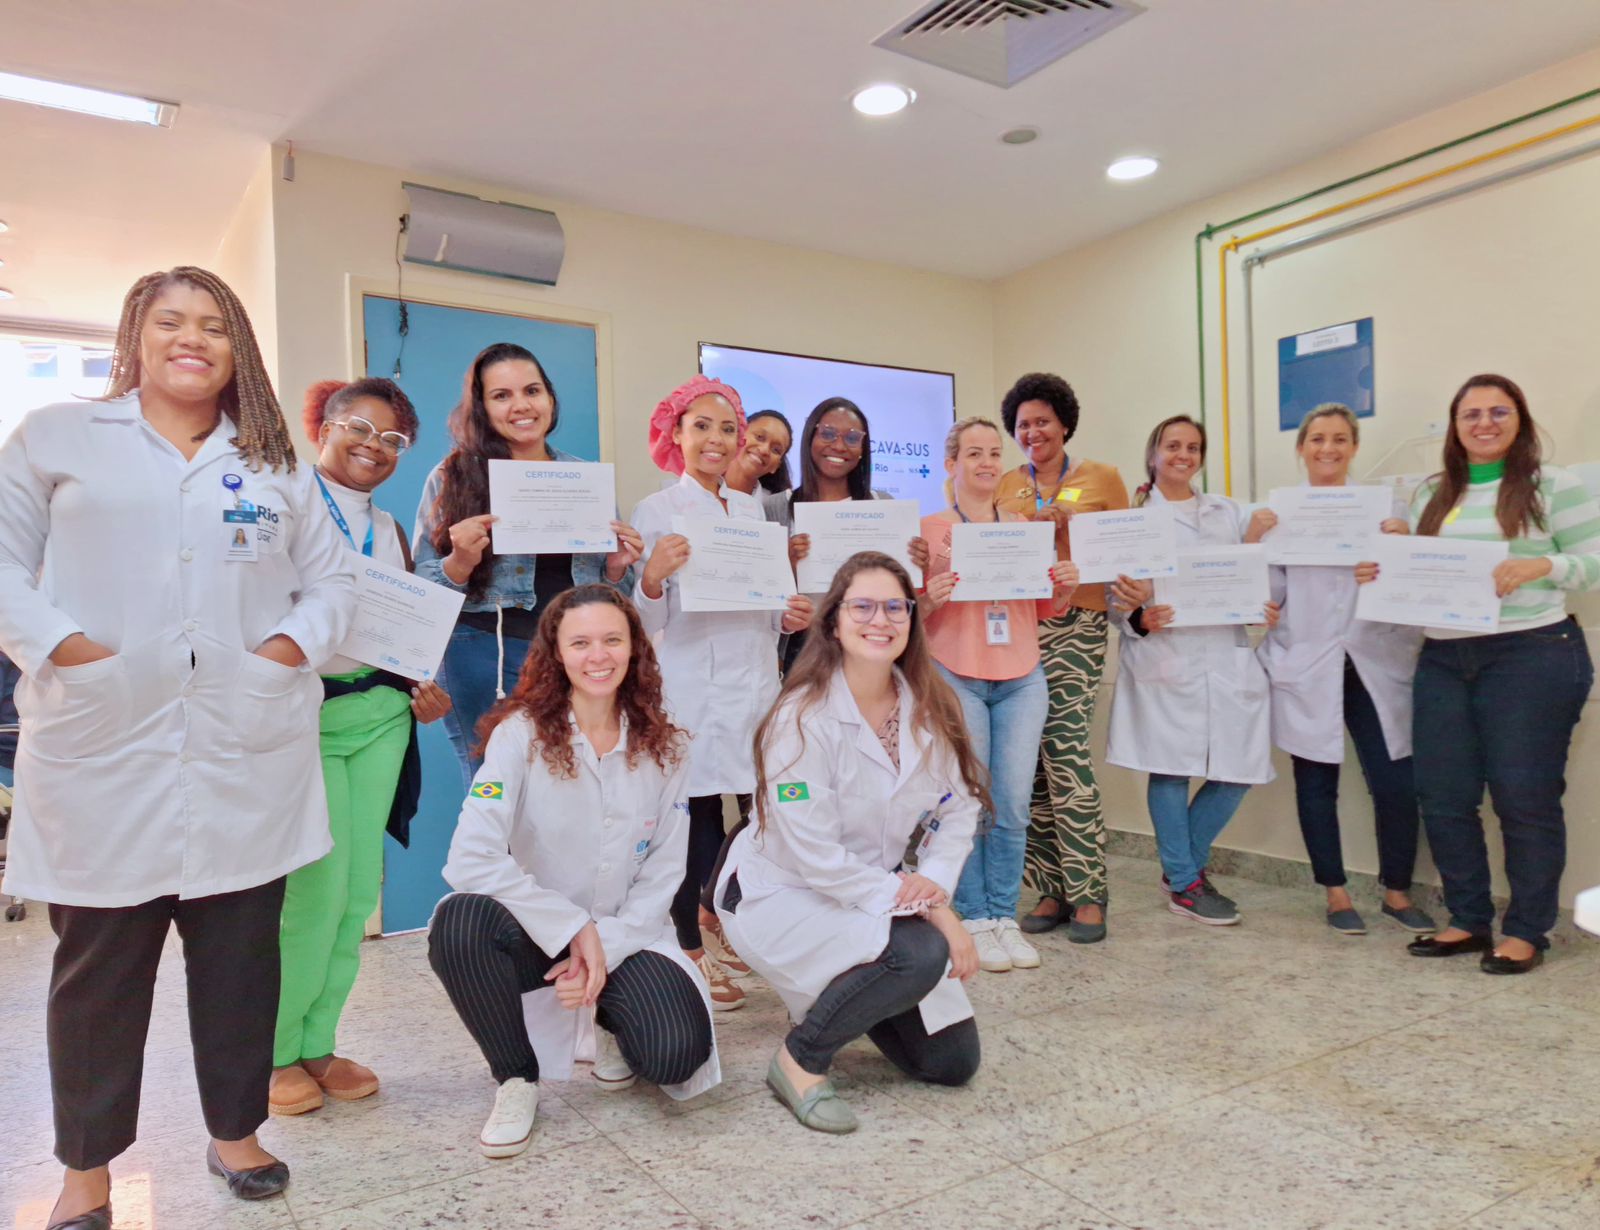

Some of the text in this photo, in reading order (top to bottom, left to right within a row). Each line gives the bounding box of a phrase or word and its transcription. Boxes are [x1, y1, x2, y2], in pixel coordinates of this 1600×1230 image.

[874, 463, 889, 472] Rio
[525, 470, 582, 479] CERTIFICADO
[257, 505, 279, 523] Rio
[714, 526, 760, 538] CERTIFICADO
[1410, 552, 1467, 561] CERTIFICADO
[364, 567, 427, 598] CERTIFICADO
